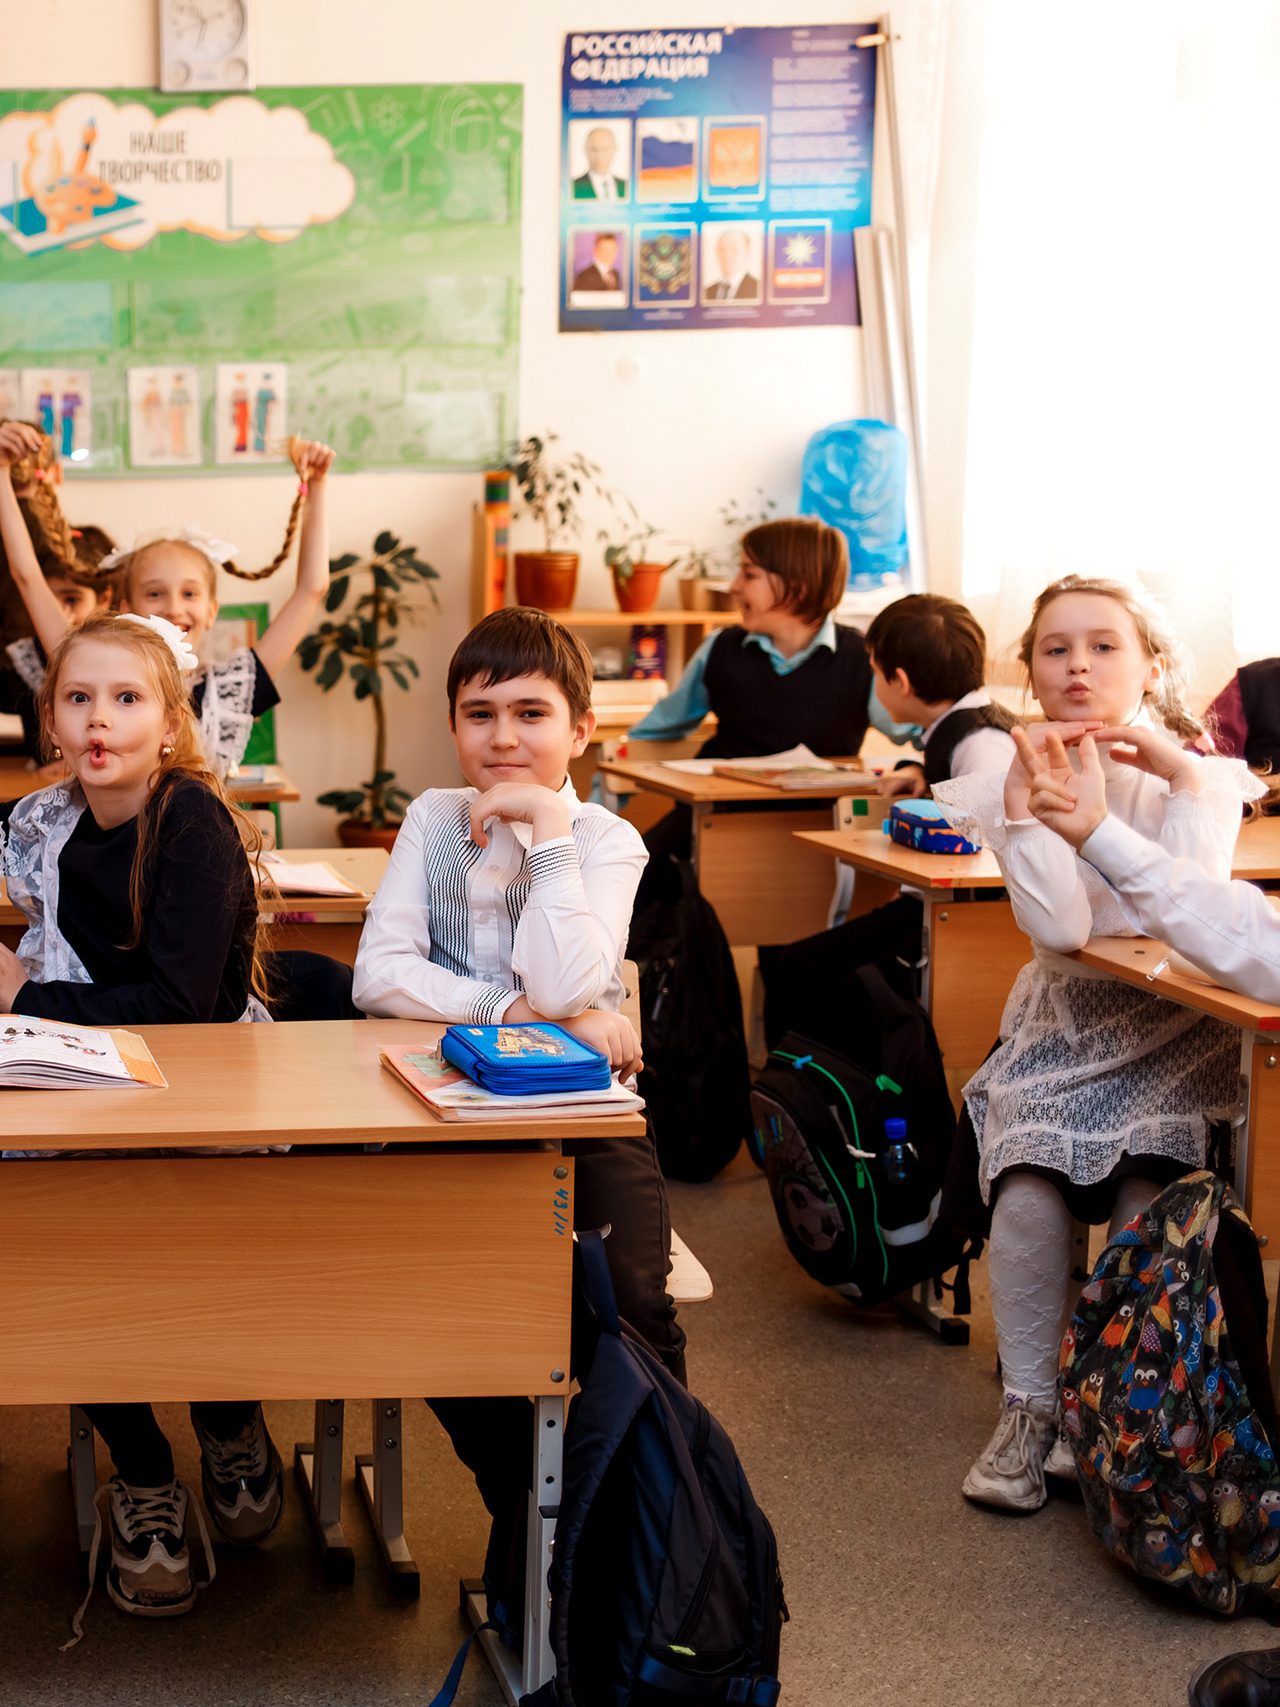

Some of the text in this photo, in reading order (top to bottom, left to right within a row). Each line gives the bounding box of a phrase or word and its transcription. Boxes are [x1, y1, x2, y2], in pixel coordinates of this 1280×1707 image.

[571, 31, 722, 57] РОССИЙСКАЯ
[571, 56, 709, 83] ФЕДЕРАЦИЯ
[130, 131, 188, 154] НАШЕ
[98, 160, 222, 183] ТВОРЧЕСТВО
